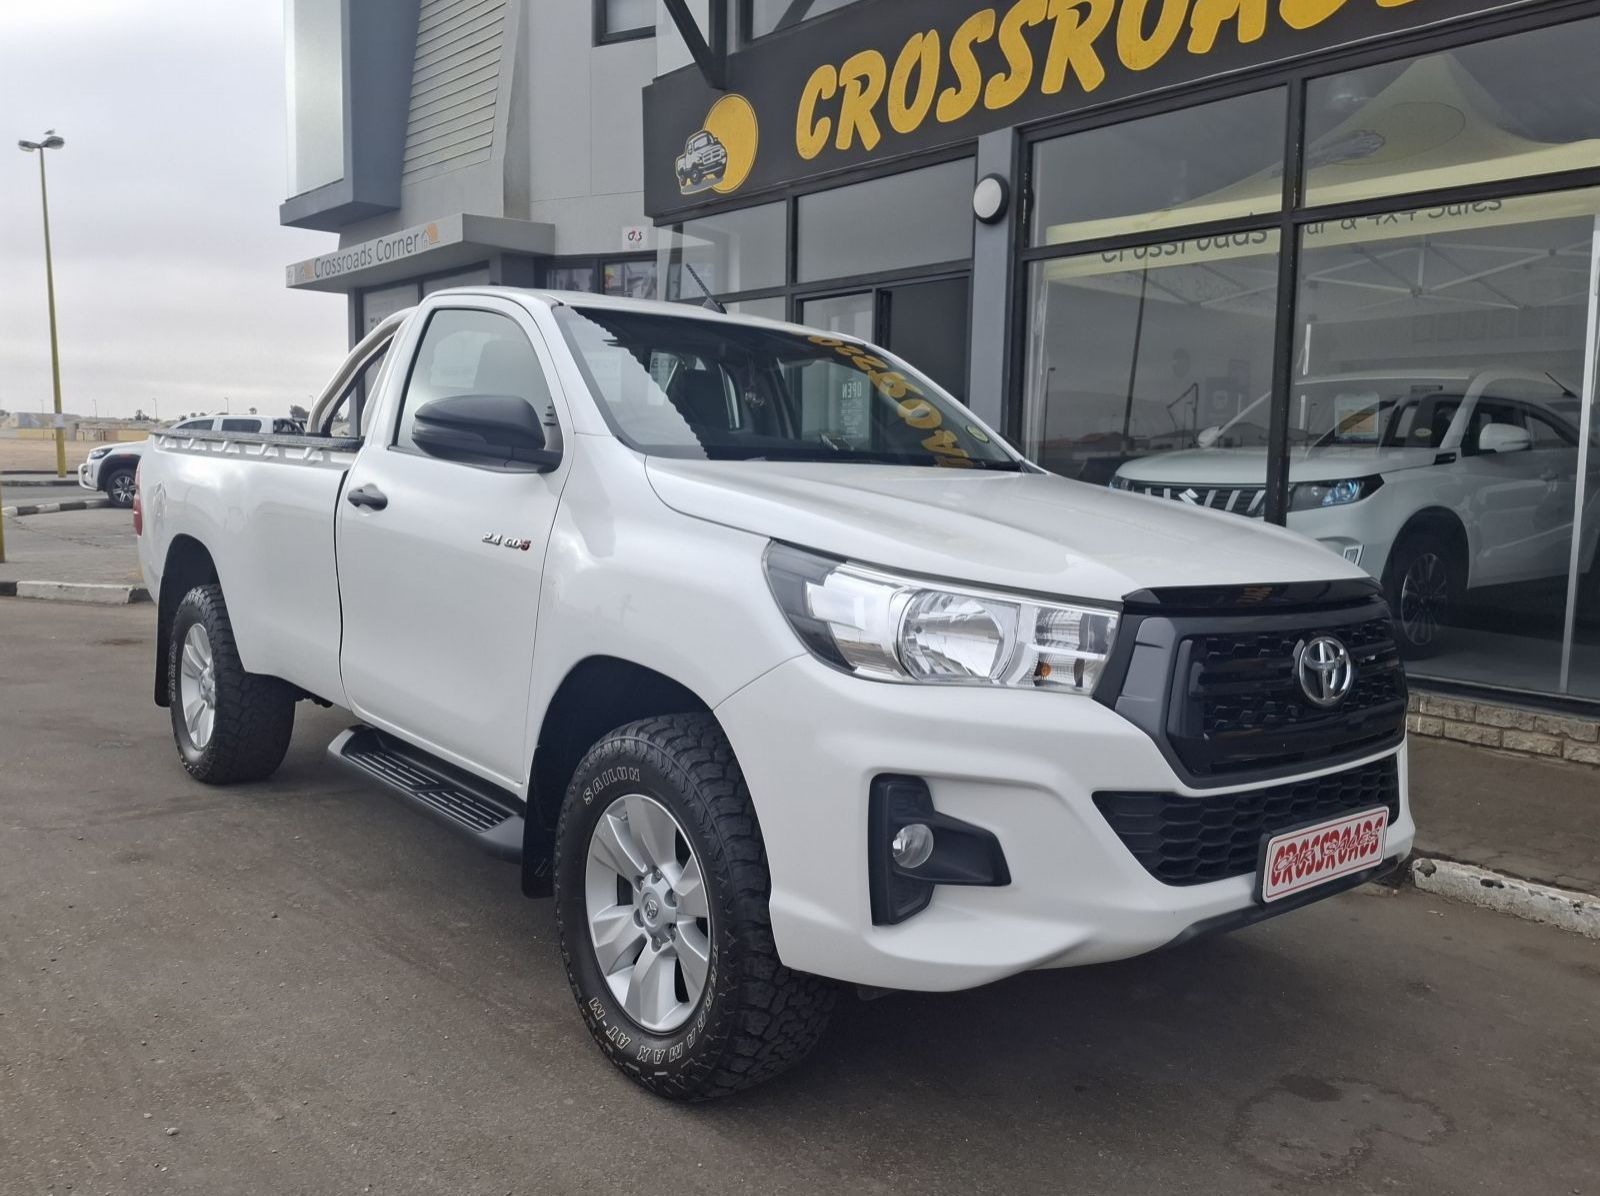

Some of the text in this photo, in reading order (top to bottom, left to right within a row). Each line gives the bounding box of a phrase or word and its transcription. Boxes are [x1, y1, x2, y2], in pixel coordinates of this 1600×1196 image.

[314, 245, 372, 278] Crossroads
[376, 232, 419, 262] Corner
[582, 766, 640, 806] SAILUN
[1271, 816, 1384, 887] CROSSROADS
[588, 997, 632, 1050] AT-M
